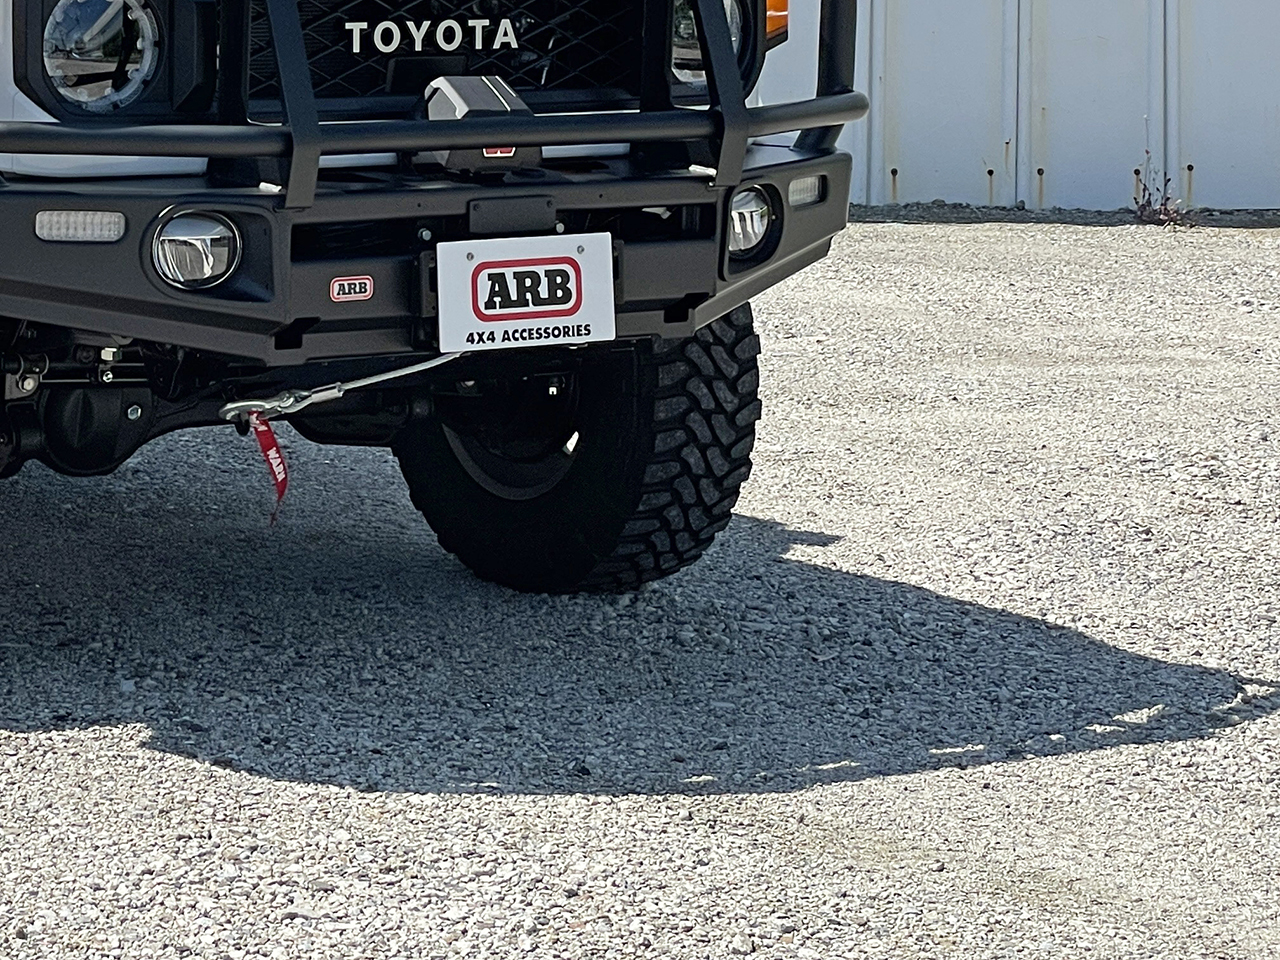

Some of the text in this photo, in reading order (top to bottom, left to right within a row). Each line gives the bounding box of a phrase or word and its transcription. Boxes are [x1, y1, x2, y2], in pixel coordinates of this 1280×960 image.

[345, 19, 519, 53] TOYOTA
[336, 281, 368, 296] ARB
[484, 269, 573, 311] ARB
[466, 324, 592, 345] 4X4 ACCESSORIES
